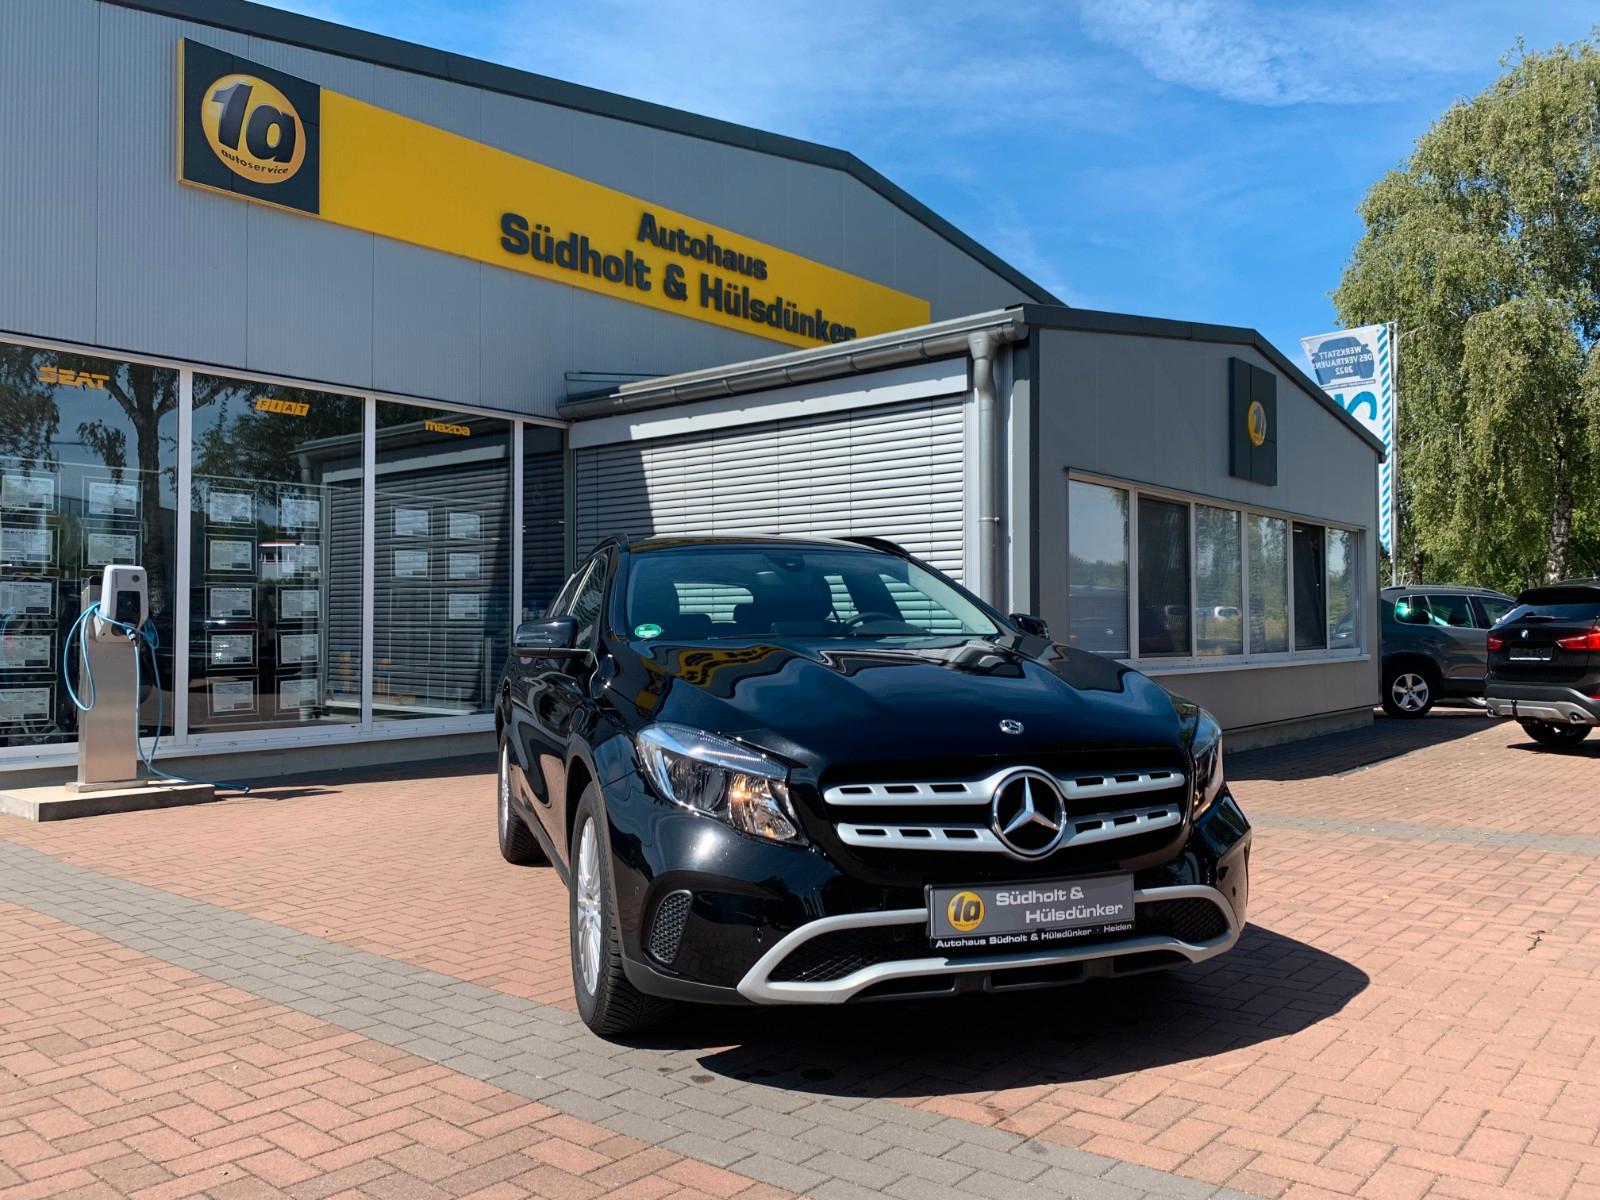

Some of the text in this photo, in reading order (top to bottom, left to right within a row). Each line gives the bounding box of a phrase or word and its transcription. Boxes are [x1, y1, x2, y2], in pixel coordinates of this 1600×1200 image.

[211, 83, 297, 163] 1a
[220, 149, 289, 175] autoservice
[500, 212, 652, 291] Südholt
[663, 264, 688, 301] &
[637, 212, 768, 281] Autohaus
[38, 366, 110, 390] SEAT
[258, 398, 309, 416] FIAT
[951, 895, 981, 922] 1a
[996, 886, 1084, 906] Südholt &
[1025, 903, 1124, 924] Hülsdünker
[935, 923, 1132, 949] Autohaus Südholt & Hülsdünker Heiden
